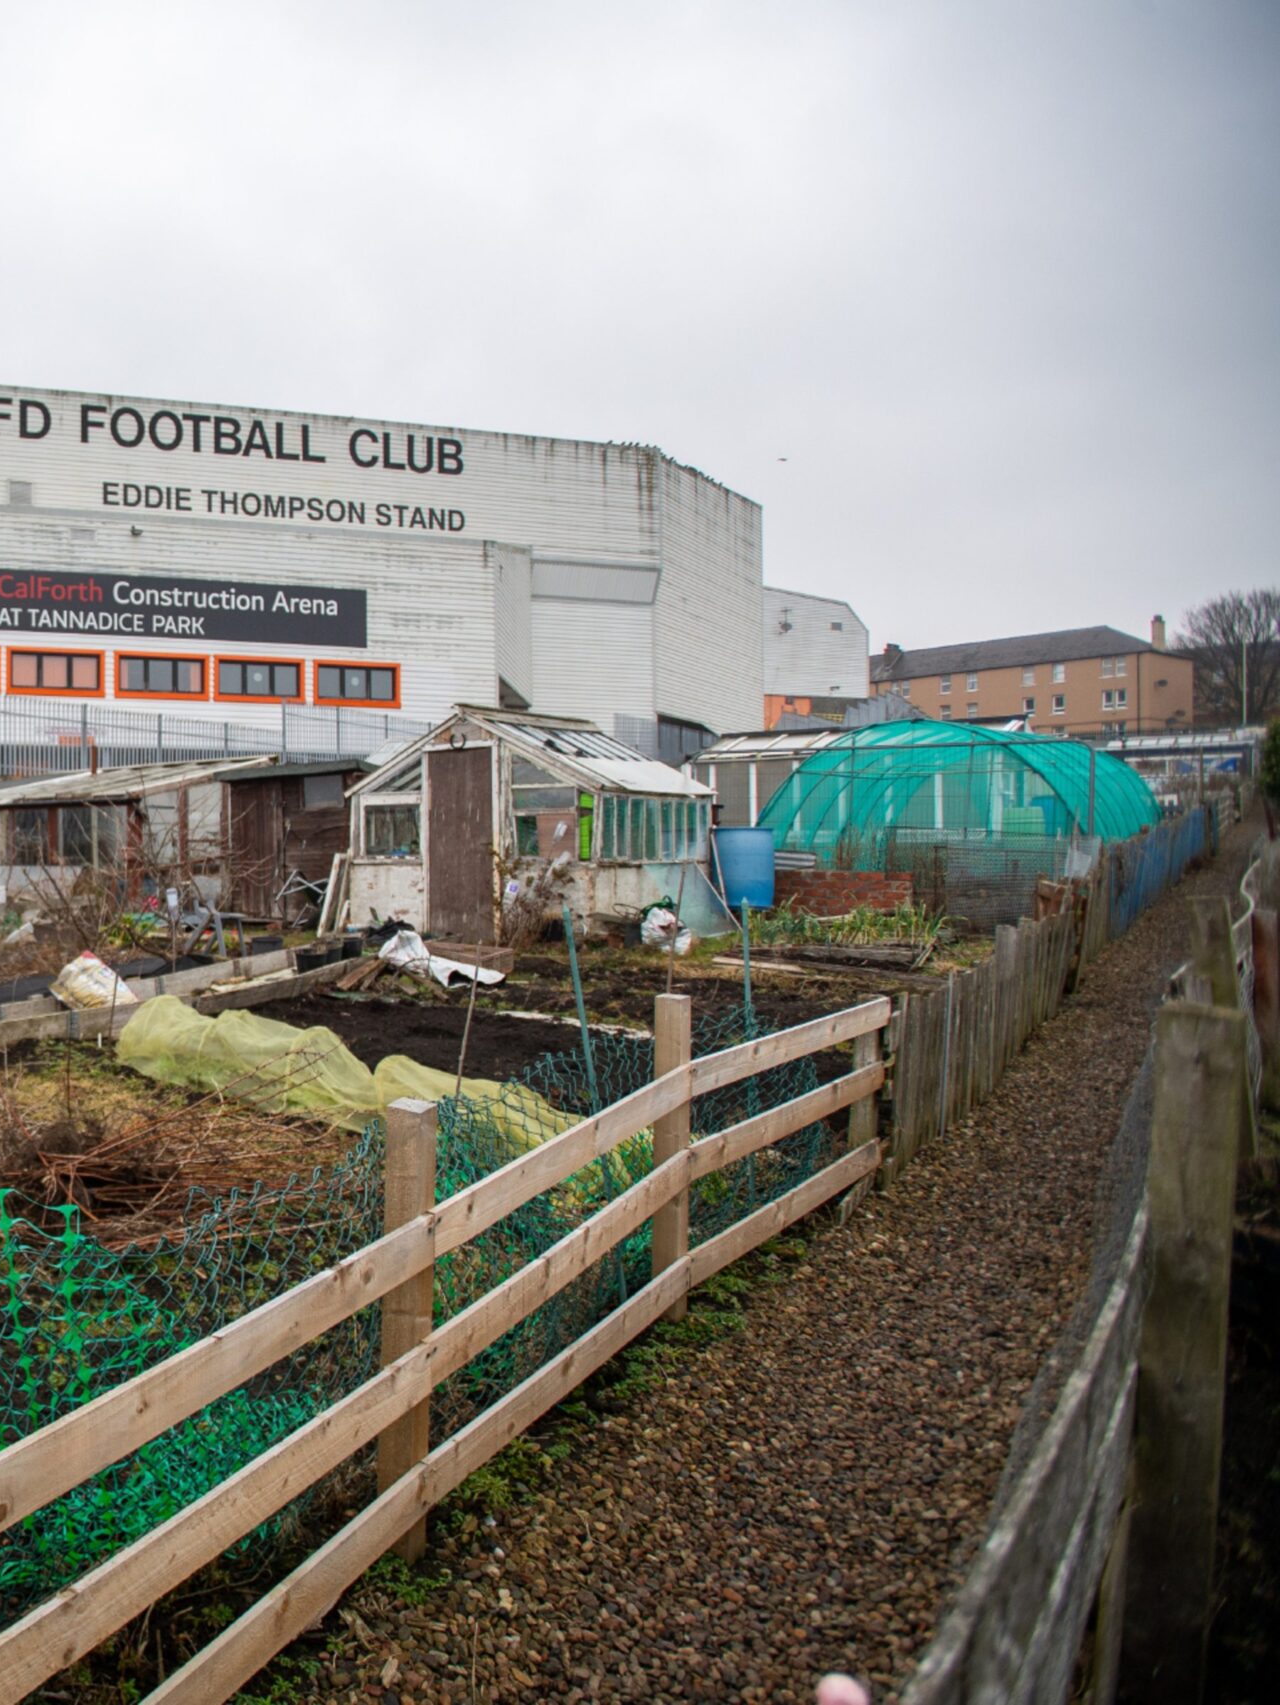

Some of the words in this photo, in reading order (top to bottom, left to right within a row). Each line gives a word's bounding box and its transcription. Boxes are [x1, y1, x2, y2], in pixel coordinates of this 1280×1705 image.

[79, 403, 326, 463] FOOTBALL
[348, 428, 465, 475] CLUB
[102, 481, 192, 512] EDDIE
[201, 488, 366, 524] THOMPSON
[375, 502, 466, 532] STAND
[112, 581, 265, 612] Construction
[271, 591, 339, 615] Arena
[27, 608, 144, 633] TANNADICE
[152, 614, 205, 635] PARK
